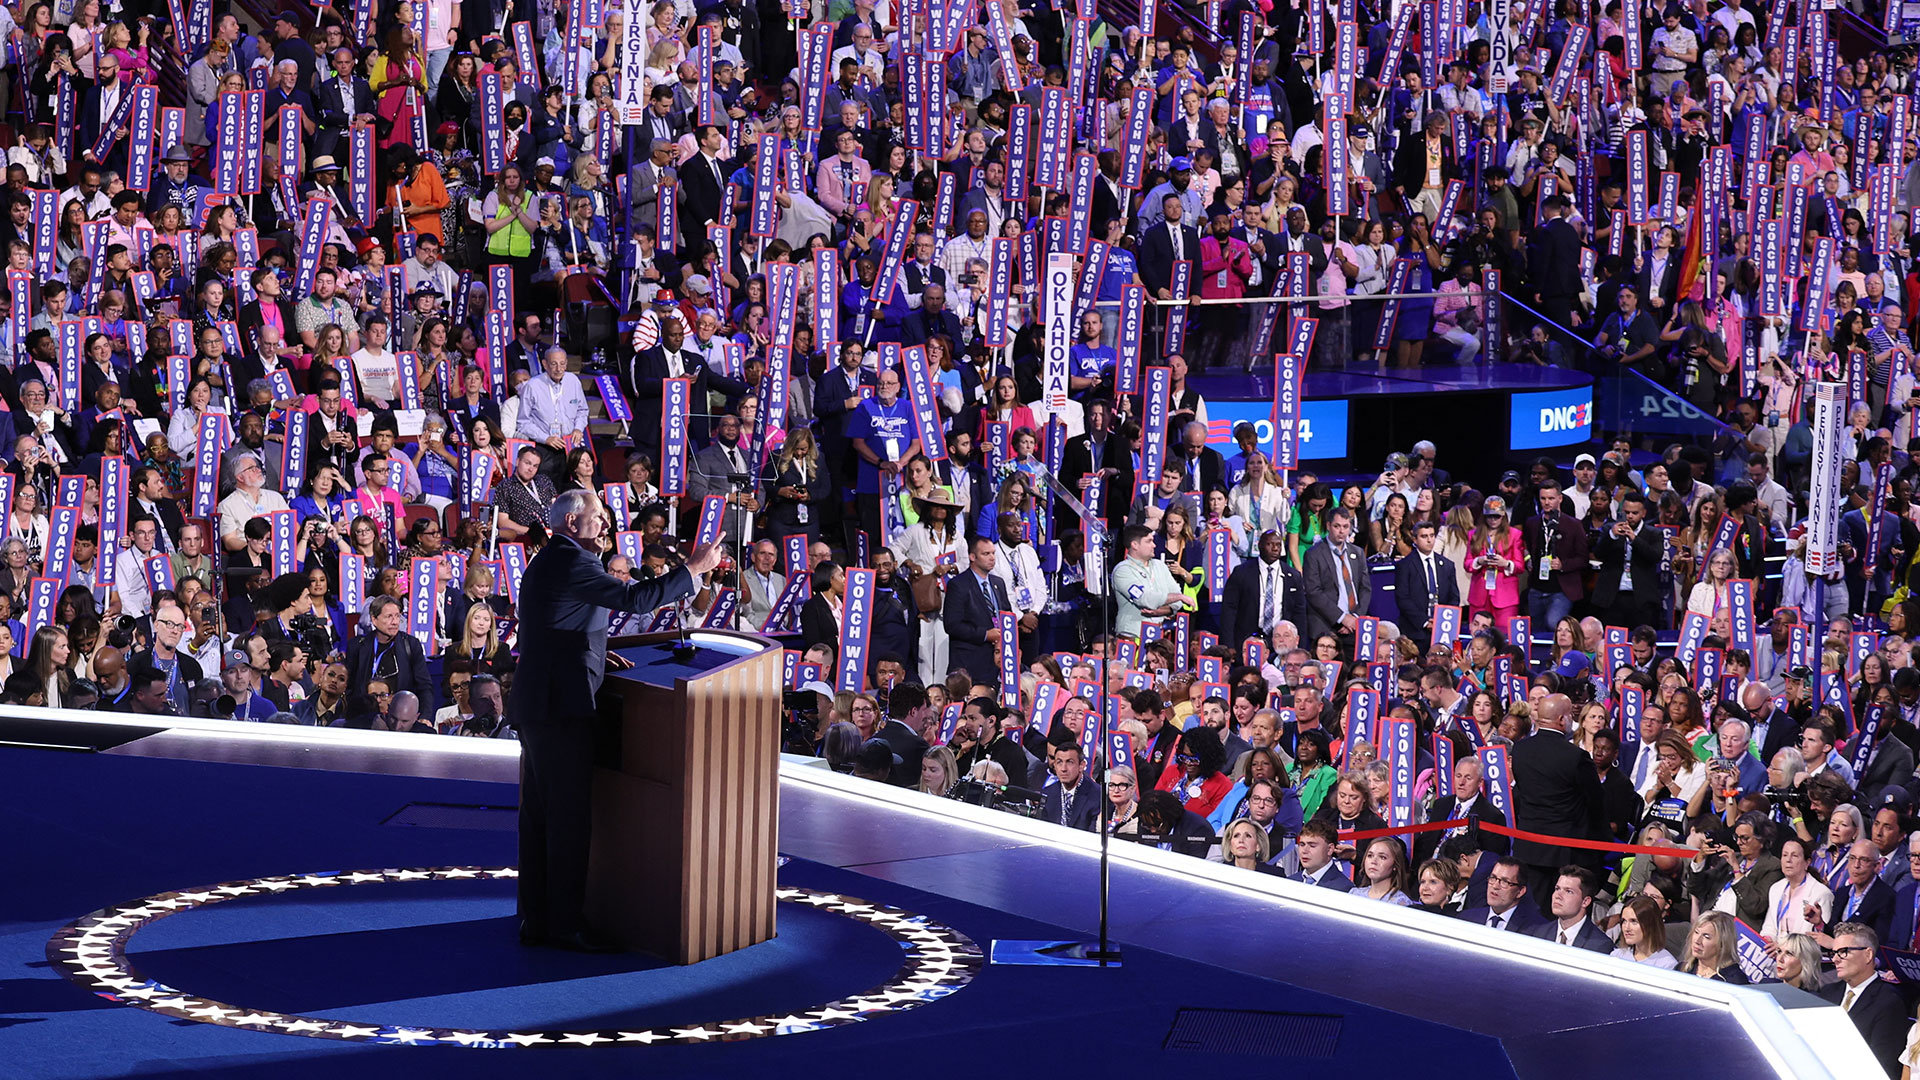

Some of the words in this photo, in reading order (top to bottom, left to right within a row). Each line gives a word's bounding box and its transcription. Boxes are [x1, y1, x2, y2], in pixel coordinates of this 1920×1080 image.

[517, 24, 531, 70] COACH
[931, 10, 942, 47] WALZ
[990, 1, 1008, 47] COACH
[1003, 51, 1016, 87] WALZ
[1076, 21, 1085, 64] COACH
[1241, 14, 1250, 59] COACH
[1343, 25, 1352, 71] COACH
[1393, 6, 1412, 52] COACH
[1422, 4, 1432, 47] COACH
[1567, 26, 1584, 66] COACH
[566, 52, 578, 91] WALZ
[626, 0, 641, 105] VIRGINIA
[810, 34, 824, 83] COACH
[1380, 50, 1399, 83] WALZ
[1423, 51, 1433, 84] WALZ
[1628, 33, 1637, 66] WALZ
[1787, 30, 1795, 68] COACH
[1826, 42, 1834, 83] COACH
[487, 74, 497, 124] COACH
[908, 57, 917, 102] COACH
[930, 64, 941, 111] COACH
[1072, 69, 1081, 104] WALZ
[1238, 64, 1247, 99] WALZ
[1822, 85, 1833, 119] WALZ
[138, 89, 151, 140] COACH
[225, 94, 236, 145] COACH
[250, 93, 259, 144] COACH
[807, 88, 819, 125] WALZ
[908, 108, 918, 144] WALZ
[1046, 90, 1057, 138] COACH
[1060, 101, 1069, 147] COACH
[1132, 91, 1147, 140] COACH
[1895, 96, 1904, 138] COACH
[285, 110, 295, 160] COACH
[488, 130, 499, 169] WALZ
[929, 116, 940, 156] WALZ
[1014, 108, 1026, 155] COACH
[1332, 122, 1341, 168] COACH
[1749, 116, 1760, 158] COACH
[1859, 116, 1868, 154] COACH
[134, 145, 147, 185] WALZ
[222, 150, 235, 191] WALZ
[246, 149, 258, 190] WALZ
[761, 137, 774, 186] COACH
[1011, 159, 1023, 197] WALZ
[1041, 143, 1054, 182] WALZ
[1056, 153, 1065, 190] WALZ
[1127, 144, 1141, 183] WALZ
[1633, 134, 1641, 179] COACH
[1712, 150, 1724, 192] COACH
[1855, 157, 1864, 188] WALZ
[940, 175, 954, 224] COACH
[1077, 157, 1091, 205] COACH
[1333, 173, 1341, 209] WALZ
[1632, 184, 1643, 221] WALZ
[1664, 174, 1674, 218] COACH
[1881, 166, 1890, 211] COACH
[41, 193, 53, 245] COACH
[307, 201, 324, 254] COACH
[758, 192, 770, 230] WALZ
[890, 202, 911, 252] COACH
[1440, 183, 1460, 226] COACH
[1793, 188, 1804, 234] COACH
[95, 224, 108, 278] COACH
[1071, 211, 1085, 250] WALZ
[1612, 213, 1621, 255] COACH
[1766, 223, 1776, 271] COACH
[1879, 214, 1888, 251] WALZ
[821, 252, 830, 304] COACH
[877, 257, 897, 298] WALZ
[996, 241, 1008, 294] COACH
[1024, 235, 1033, 281] COACH
[1084, 243, 1102, 292] COACH
[1788, 236, 1800, 274] WALZ
[1813, 238, 1829, 286] COACH
[17, 281, 26, 337] COACH
[1126, 288, 1137, 340] COACH
[1764, 274, 1776, 311] WALZ
[1806, 290, 1821, 328] WALZ
[491, 312, 501, 367] COACH
[992, 299, 1004, 341] WALZ
[1050, 271, 1067, 391] OKLAHOMA
[1170, 315, 1184, 353] WALZ
[66, 324, 77, 382] COACH
[1122, 347, 1135, 389] WALZ
[402, 354, 417, 409] COACH
[908, 349, 928, 406] COACH
[920, 411, 939, 456] WALZ
[1151, 371, 1163, 426] COACH
[1282, 358, 1293, 413] COACH
[669, 382, 681, 439] COACH
[1540, 408, 1576, 432] DNC
[201, 417, 216, 476] COACH
[289, 412, 303, 471] COACH
[1147, 433, 1159, 480] WALZ
[1280, 420, 1293, 464] WALZ
[666, 445, 680, 490] WALZ
[1811, 404, 1827, 545] PENNSYLVANIA
[1828, 405, 1842, 546] PENNSYLVANIA
[106, 460, 116, 523] COACH
[52, 511, 70, 572] COACH
[103, 530, 116, 580] WALZ
[1216, 533, 1224, 589] COACH
[417, 561, 430, 624] COACH
[850, 572, 866, 638] COACH
[1734, 583, 1747, 642] COACH
[844, 645, 861, 685] WAL
[1004, 616, 1014, 685] COACH
[1626, 691, 1636, 741] COAC
[1397, 722, 1409, 797] COACH
[1853, 708, 1880, 771] COACH
[1486, 752, 1503, 806] COAC
